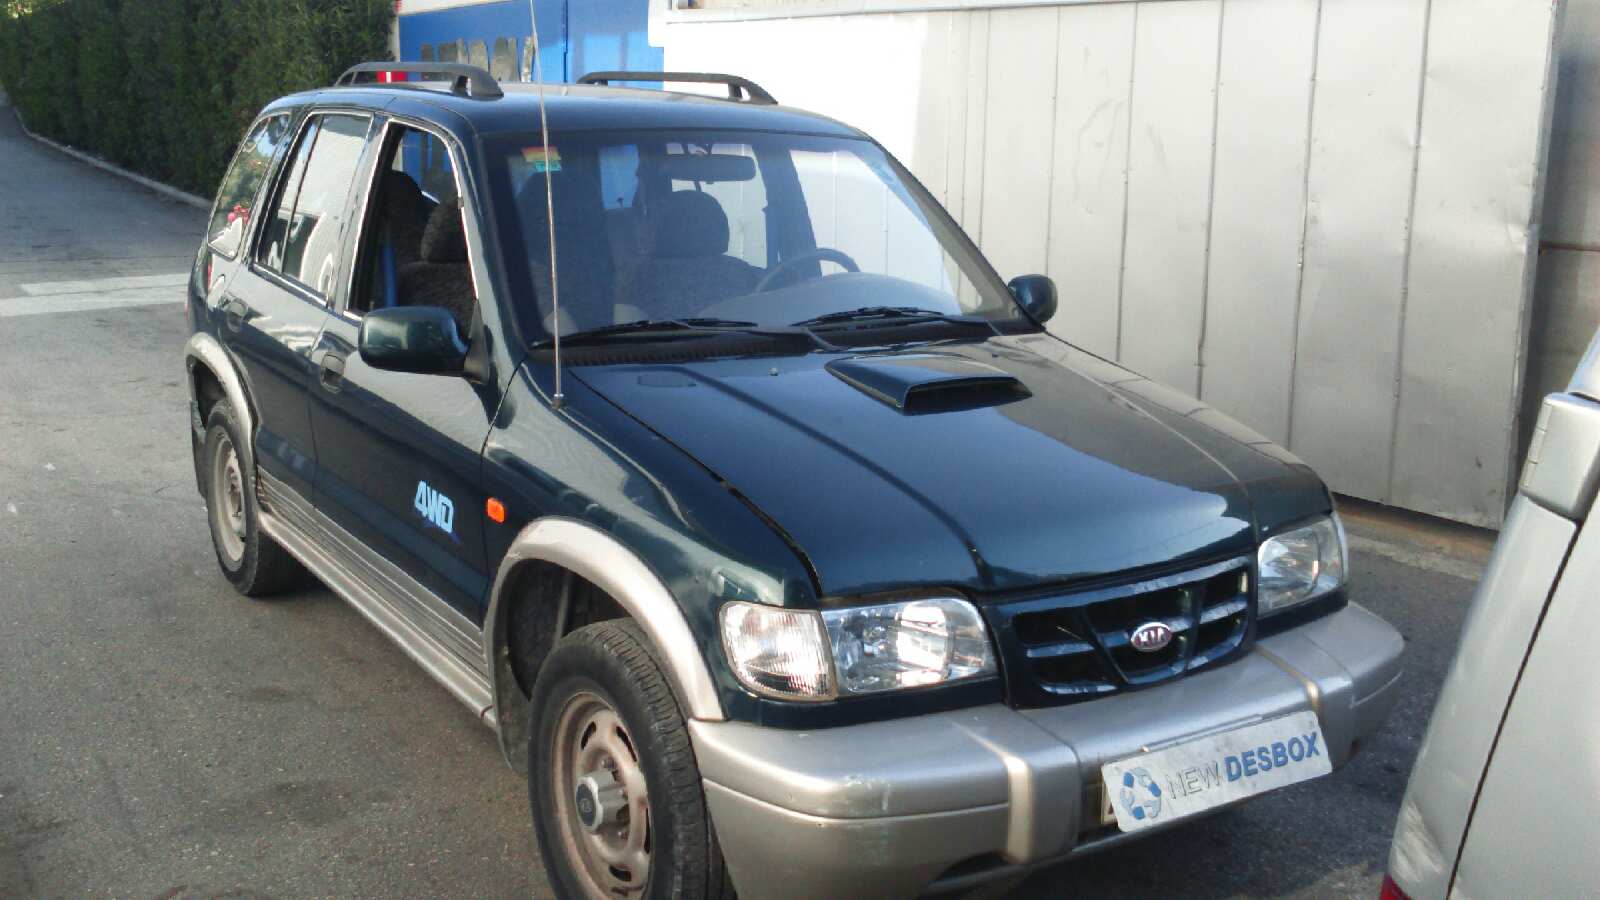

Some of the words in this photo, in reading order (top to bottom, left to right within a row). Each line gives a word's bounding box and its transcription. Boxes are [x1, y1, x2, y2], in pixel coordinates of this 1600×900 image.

[414, 480, 454, 534] 4WD
[1138, 627, 1168, 647] KIA
[1166, 760, 1220, 799] NEW
[1225, 731, 1320, 783] DESBOX
